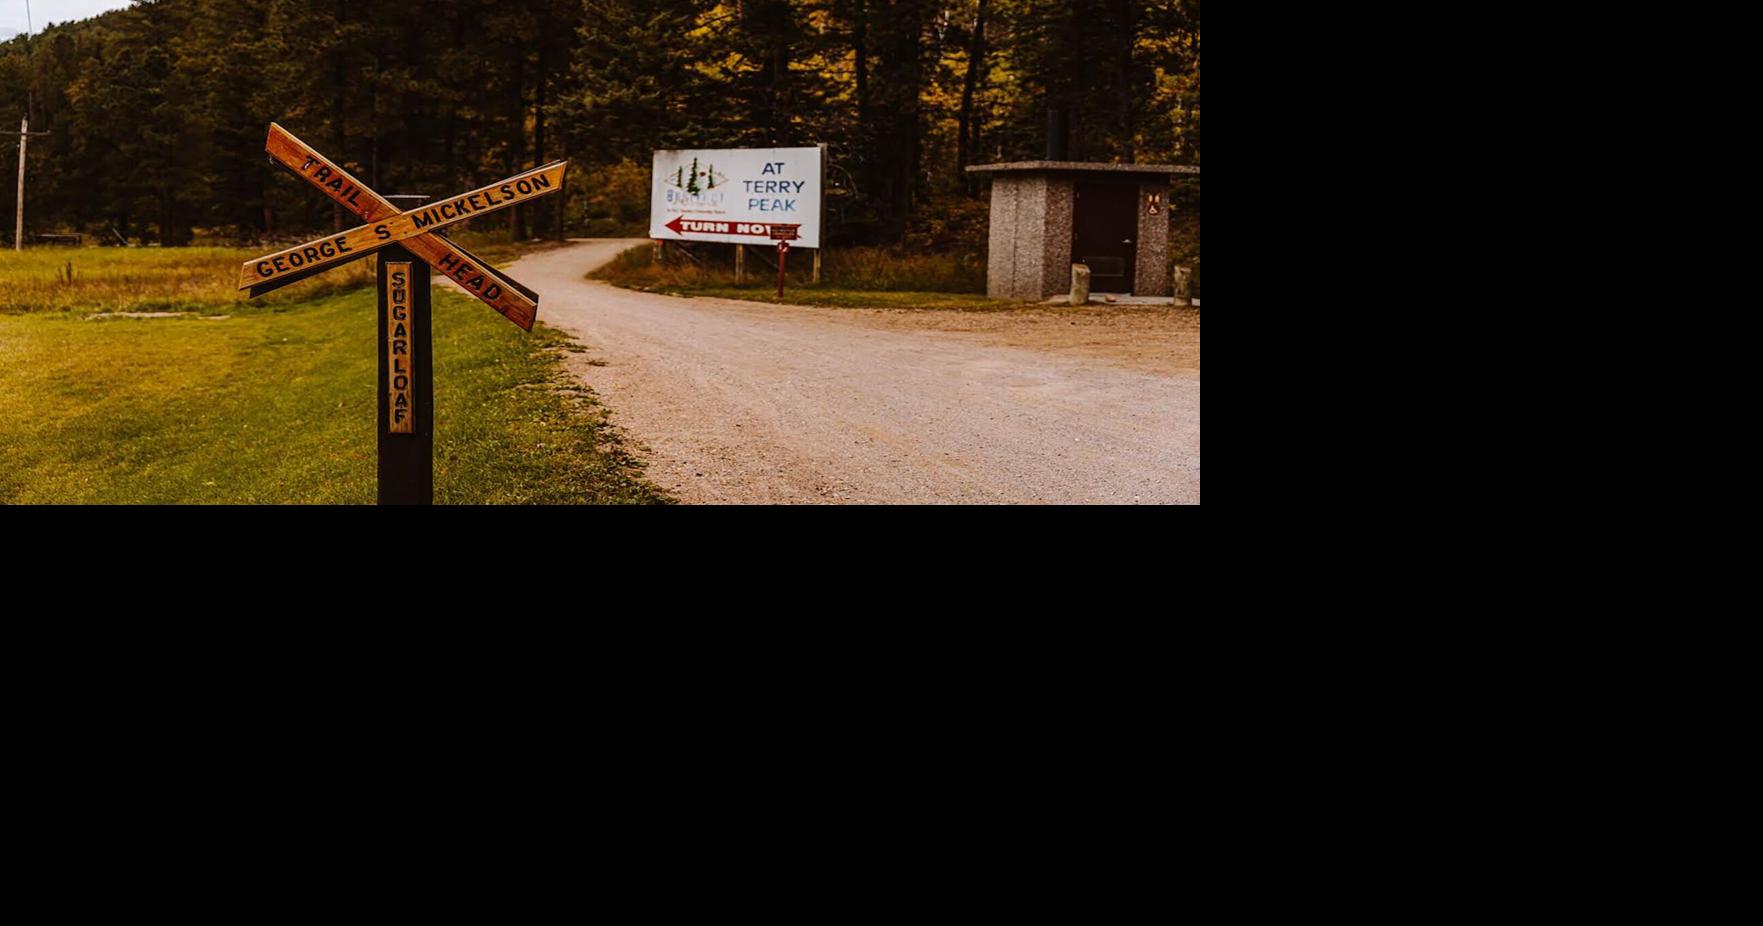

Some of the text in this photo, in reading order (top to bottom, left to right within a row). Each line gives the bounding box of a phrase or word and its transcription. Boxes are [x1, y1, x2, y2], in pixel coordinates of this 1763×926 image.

[761, 162, 785, 175] AT
[742, 180, 805, 193] TERRY
[748, 198, 796, 211] PEAK
[256, 174, 550, 278] GEORGE S MICKELSON
[301, 155, 502, 300] TRAIL HEAD
[681, 221, 729, 233] TURN
[391, 272, 408, 424] SUGARLOAF
